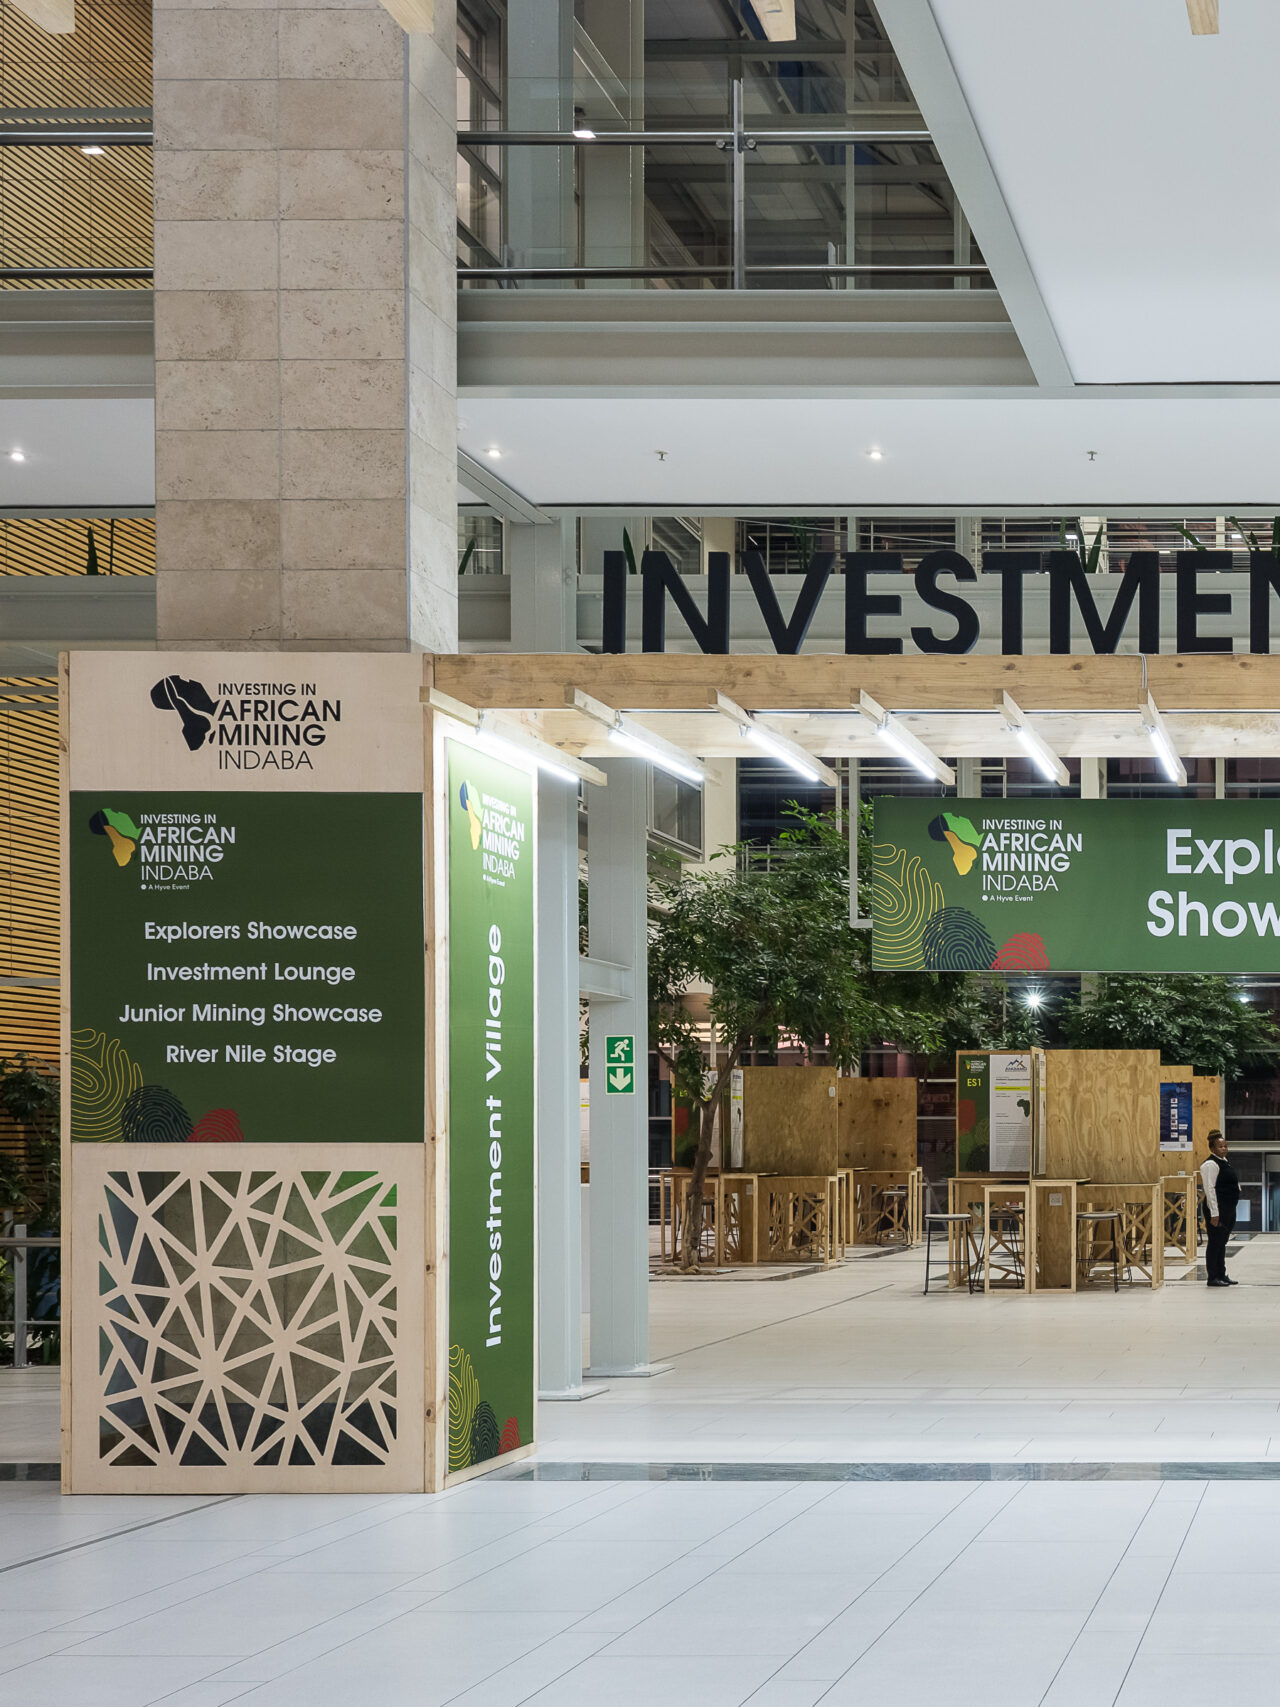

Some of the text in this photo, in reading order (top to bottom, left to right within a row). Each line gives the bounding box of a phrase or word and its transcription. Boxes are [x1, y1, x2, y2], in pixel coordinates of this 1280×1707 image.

[218, 683, 316, 696] INVESTING IN
[219, 700, 341, 721] AFRICAN
[218, 723, 327, 747] MINING
[219, 750, 314, 770] INDABA
[140, 813, 217, 825] INVESTING IN
[482, 809, 524, 841] AFRICAN
[982, 819, 1063, 831] INVESTING IN
[141, 827, 235, 844] AFRICAN
[482, 829, 519, 860] MINING
[982, 833, 1082, 852] AFRICAN
[140, 844, 224, 863] MINING
[982, 852, 1071, 873] MINING
[141, 864, 214, 881] INDABA
[483, 852, 515, 879] INDABA
[982, 874, 1059, 892] INDABA
[989, 894, 1034, 903] A Hyve Event
[144, 921, 358, 944] Explorers Showcase
[147, 962, 356, 986] Investment Lounge
[118, 1003, 383, 1026] Junior Mining Showcase
[166, 1044, 337, 1068] River Nile Stage
[486, 923, 505, 1346] Investment Village
